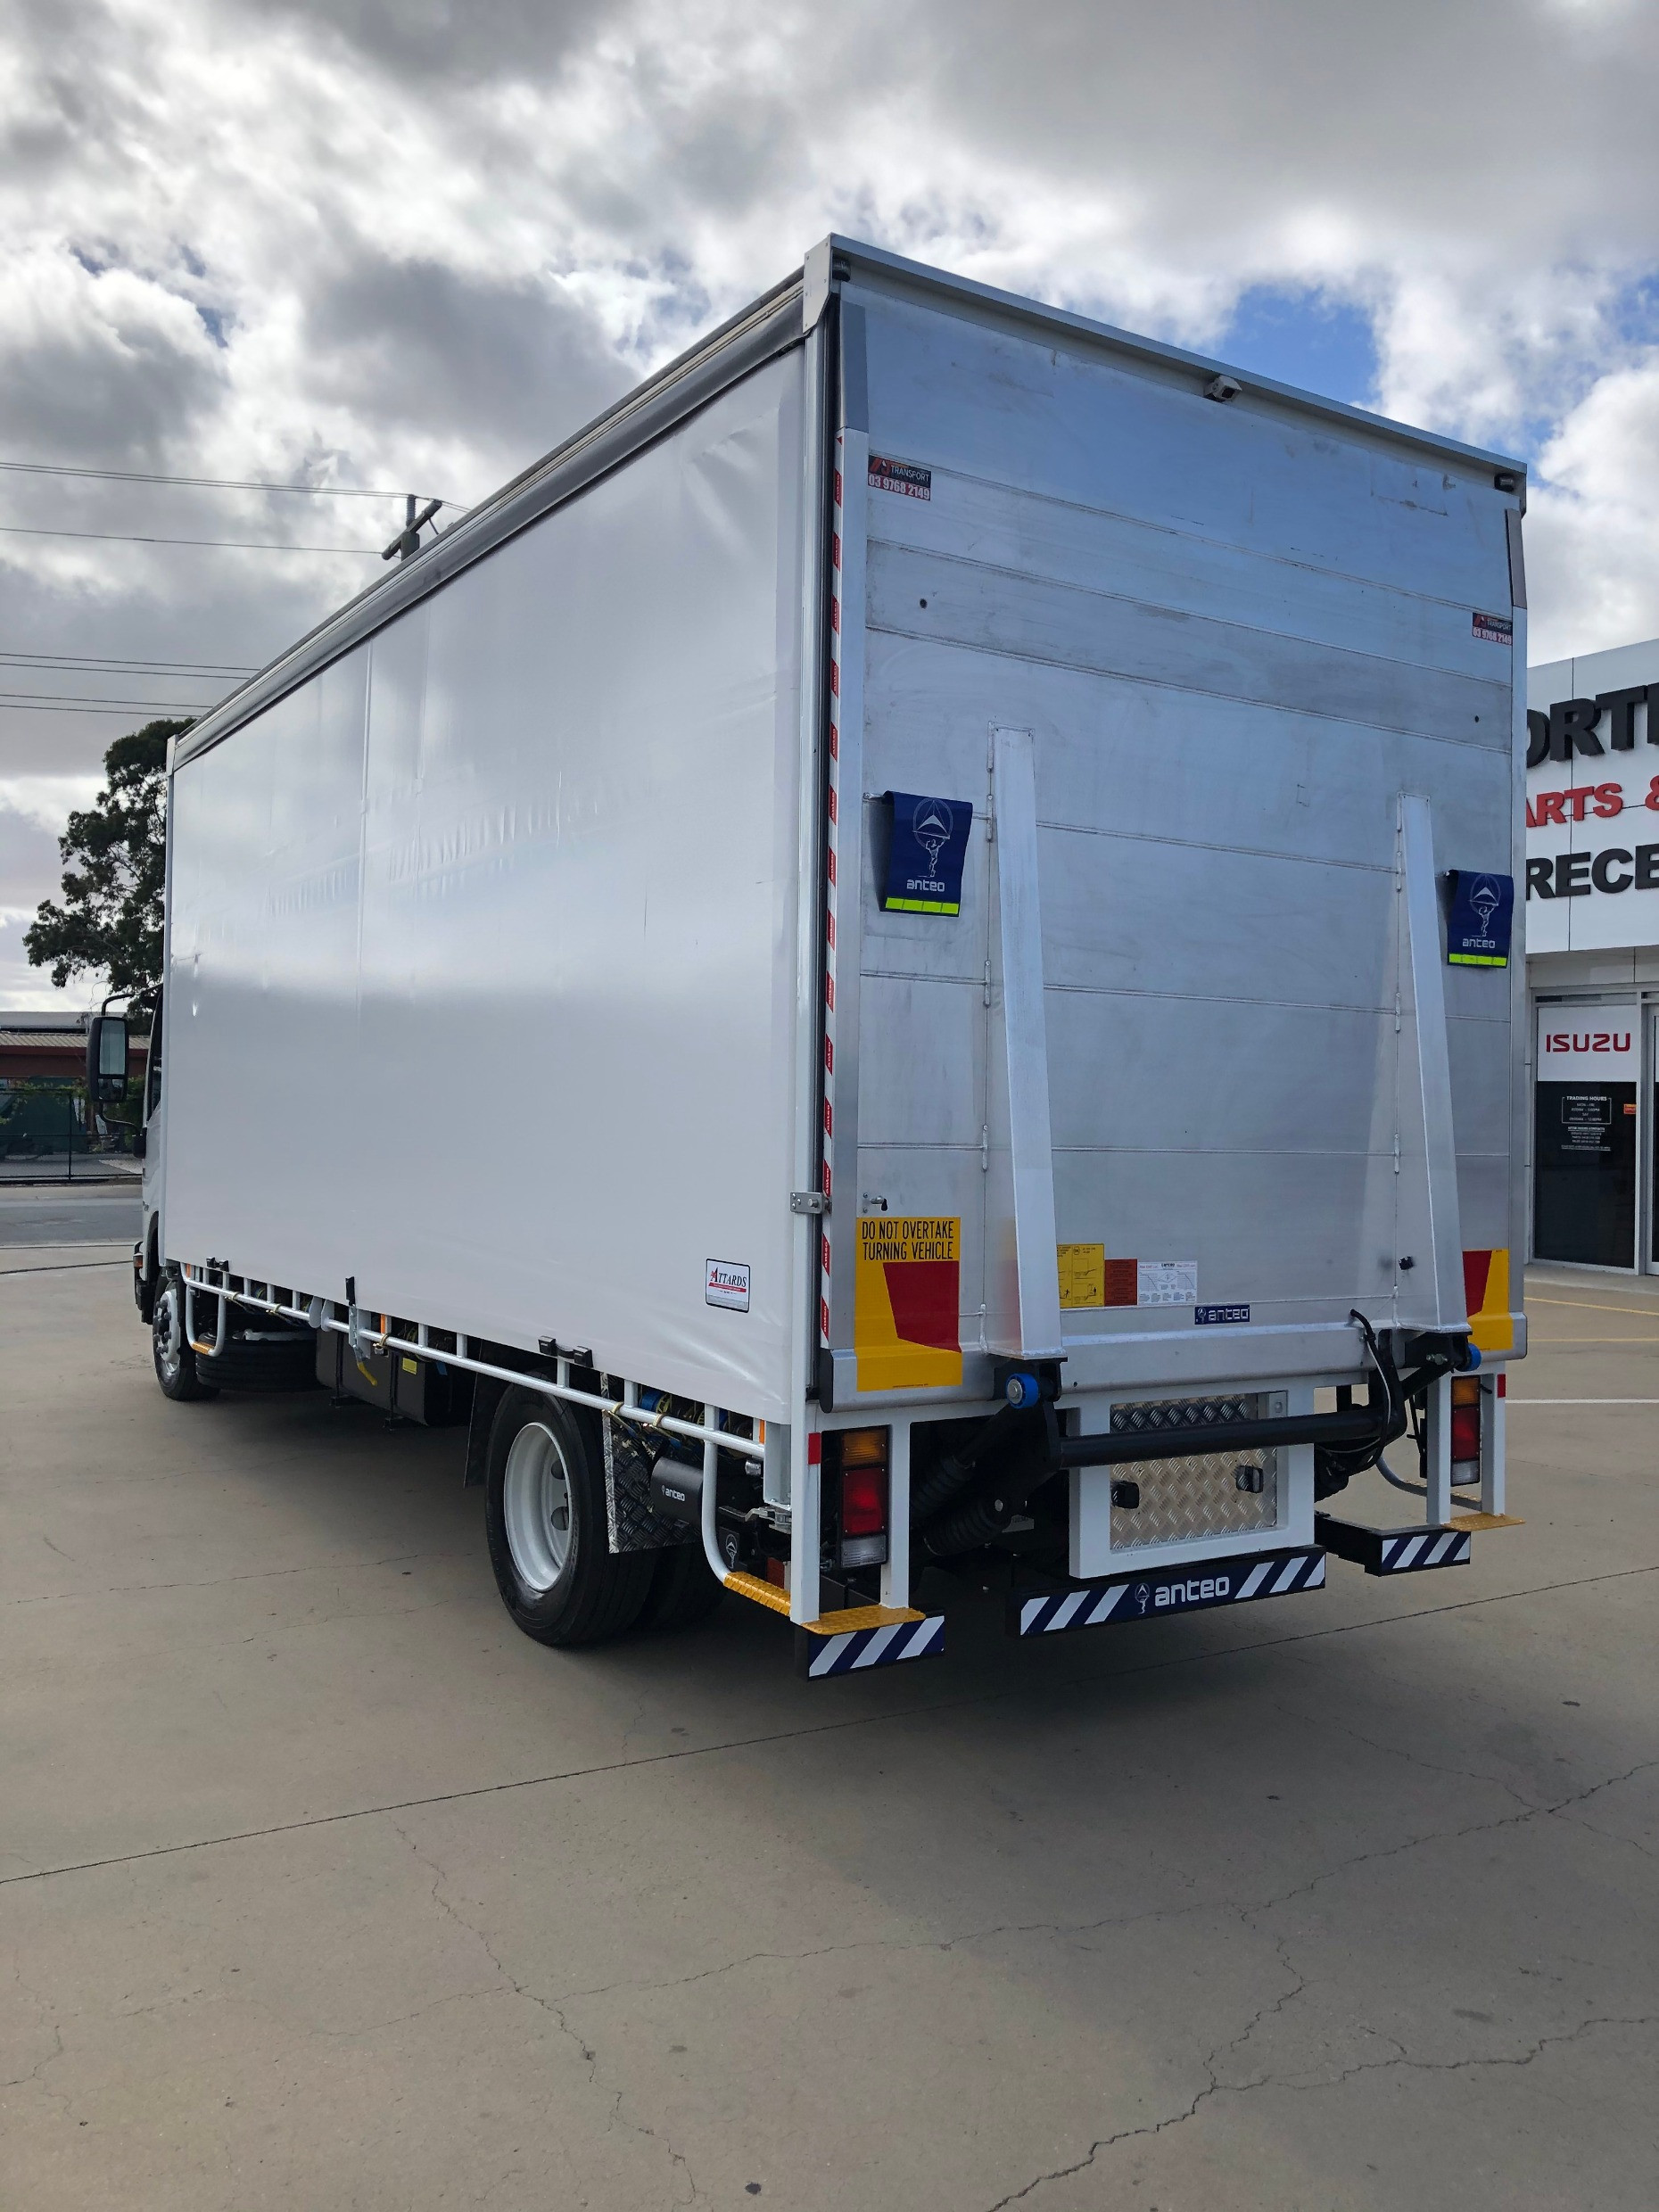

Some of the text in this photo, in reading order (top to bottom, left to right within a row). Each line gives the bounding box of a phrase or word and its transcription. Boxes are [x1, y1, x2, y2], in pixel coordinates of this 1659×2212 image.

[891, 465, 929, 482] TRANSPORT
[869, 474, 930, 500] 03 9768 2149
[1526, 682, 1659, 768] RT
[906, 879, 945, 893] anteo
[1462, 937, 1496, 949] anteo
[1546, 1033, 1630, 1053] ISUZU
[862, 1220, 954, 1240] DO NOT OVERTAKE
[863, 1241, 953, 1260] TURNING VEHICLE
[710, 1267, 747, 1287] ATTARDS
[1208, 1308, 1249, 1321] anteo
[1155, 1576, 1230, 1606] anteo
